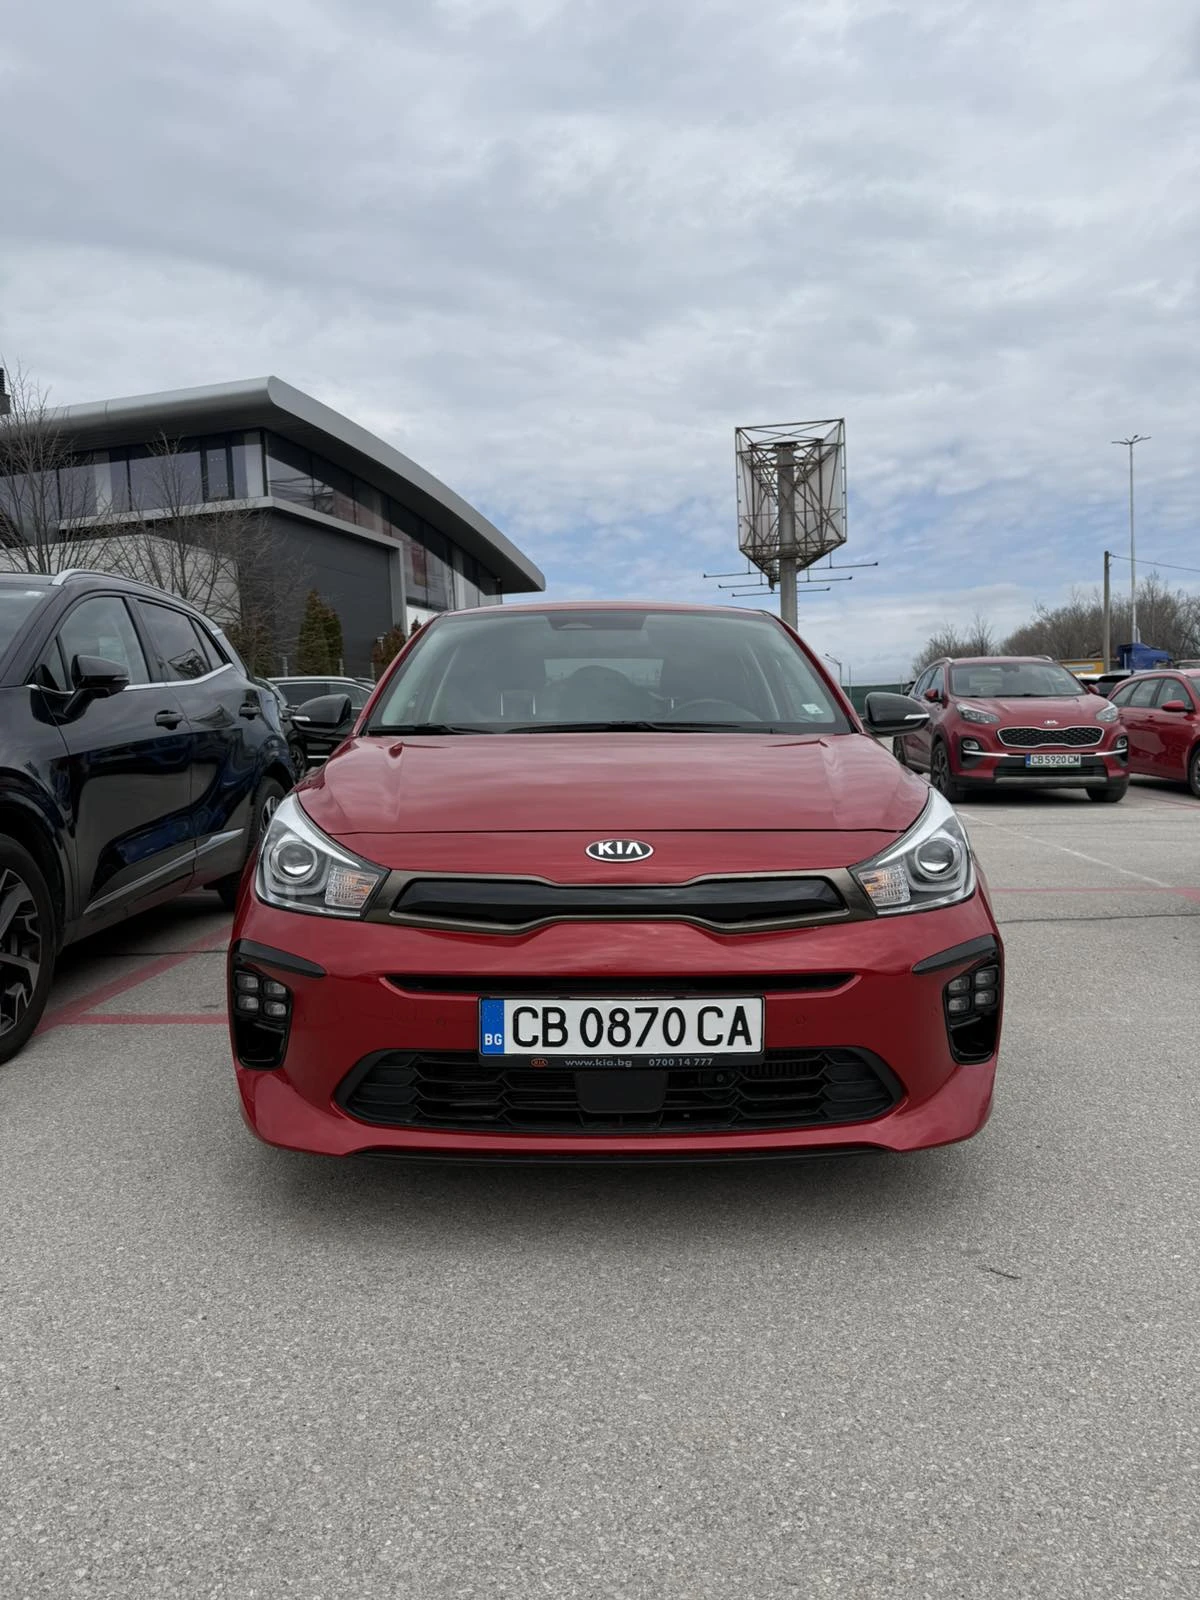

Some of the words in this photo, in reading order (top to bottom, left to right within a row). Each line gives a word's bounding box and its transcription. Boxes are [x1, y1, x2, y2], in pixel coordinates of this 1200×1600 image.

[1031, 755, 1044, 764] CB
[1044, 755, 1067, 764] 5920
[1067, 755, 1080, 764] CM
[598, 841, 643, 856] KIA
[512, 1006, 569, 1047] CB
[579, 1006, 687, 1048] 0870
[697, 1005, 753, 1047] CA
[485, 1033, 503, 1046] BG
[564, 1058, 633, 1068] www.kia.bg
[648, 1058, 675, 1067] 0700
[678, 1058, 691, 1066] 14
[693, 1057, 713, 1066] 777
